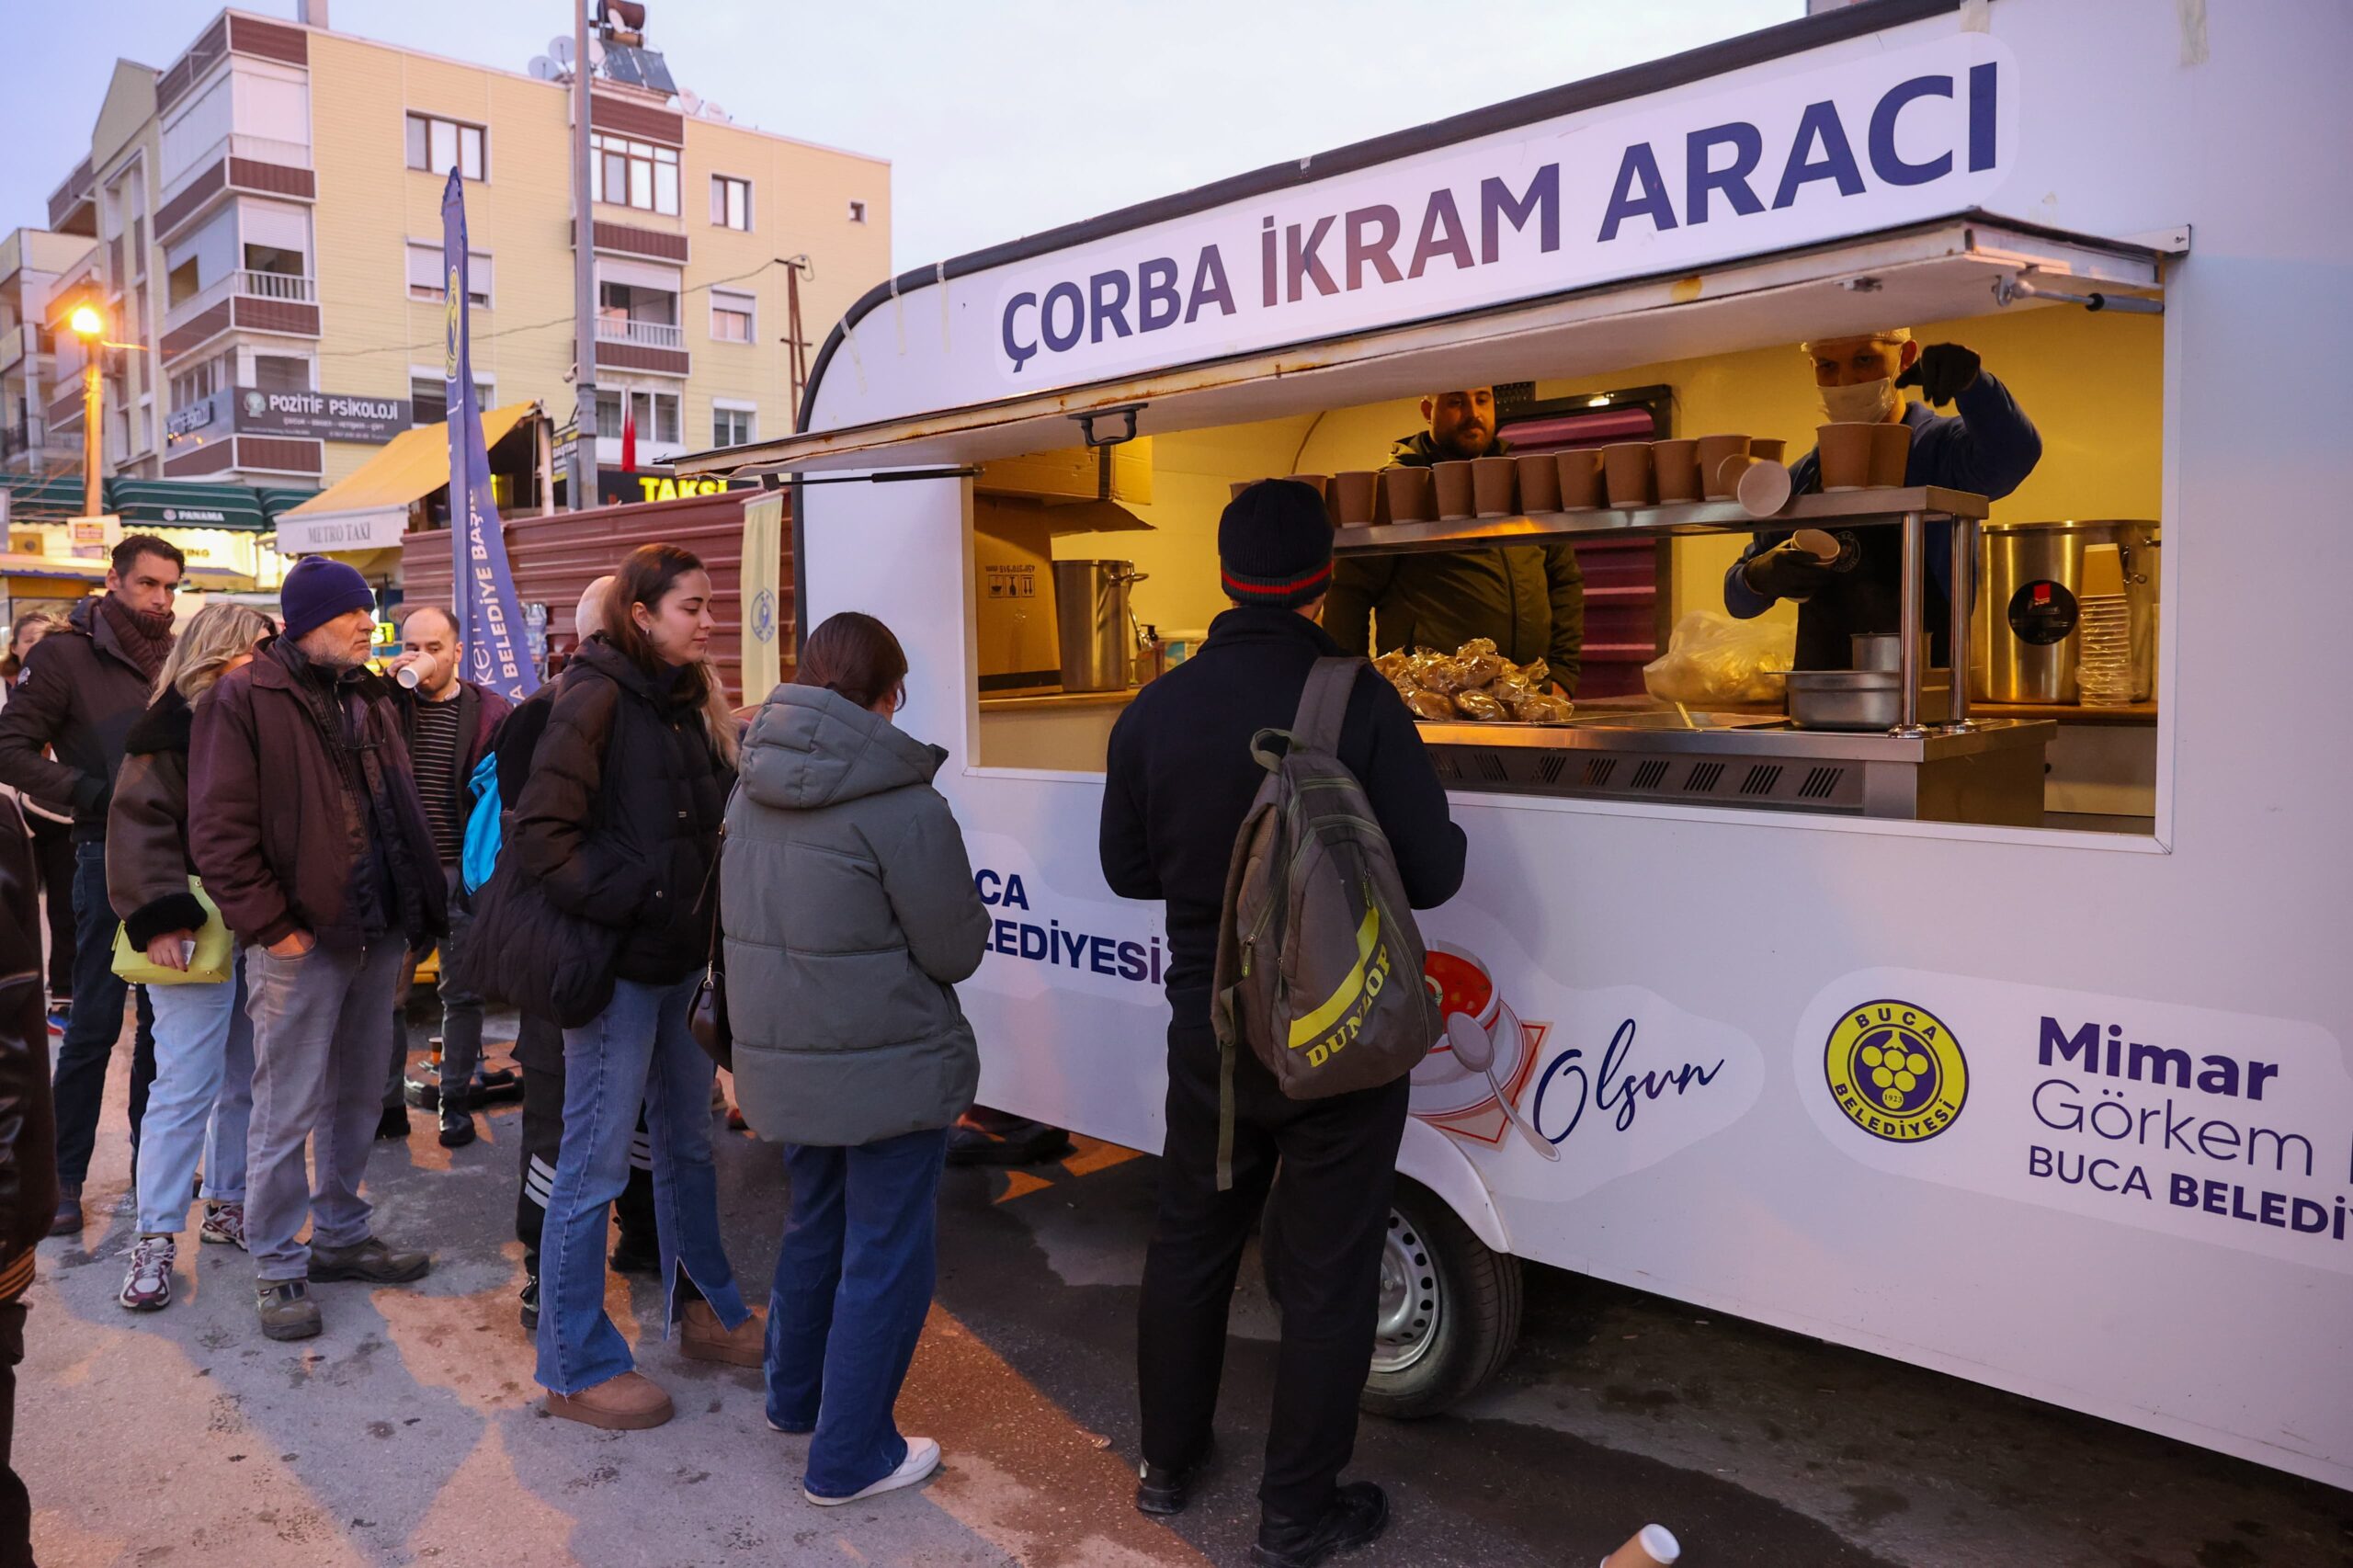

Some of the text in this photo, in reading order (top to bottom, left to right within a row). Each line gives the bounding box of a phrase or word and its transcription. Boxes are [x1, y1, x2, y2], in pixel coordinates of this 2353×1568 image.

[1002, 62, 1997, 372] ÇORBA İKRAM ARACI
[269, 393, 398, 420] POZİTİF PSİKOLOJİ
[178, 510, 225, 522] PANAMA
[308, 525, 344, 543] METRO
[474, 566, 519, 678] BELEDİYE
[975, 869, 1030, 911] CA
[984, 918, 1161, 985] EDİYESİ
[1306, 943, 1390, 1067] DUNLOP
[1855, 1007, 1937, 1041] BUCA
[1532, 1017, 1725, 1144] Olsun
[2038, 1016, 2279, 1101] Mimar
[1835, 1083, 1956, 1137] BELEDİYESİ
[1883, 1094, 1903, 1103] 1923
[2031, 1079, 2313, 1176] Görkem
[2029, 1145, 2353, 1241] BUCA BELEDİ
